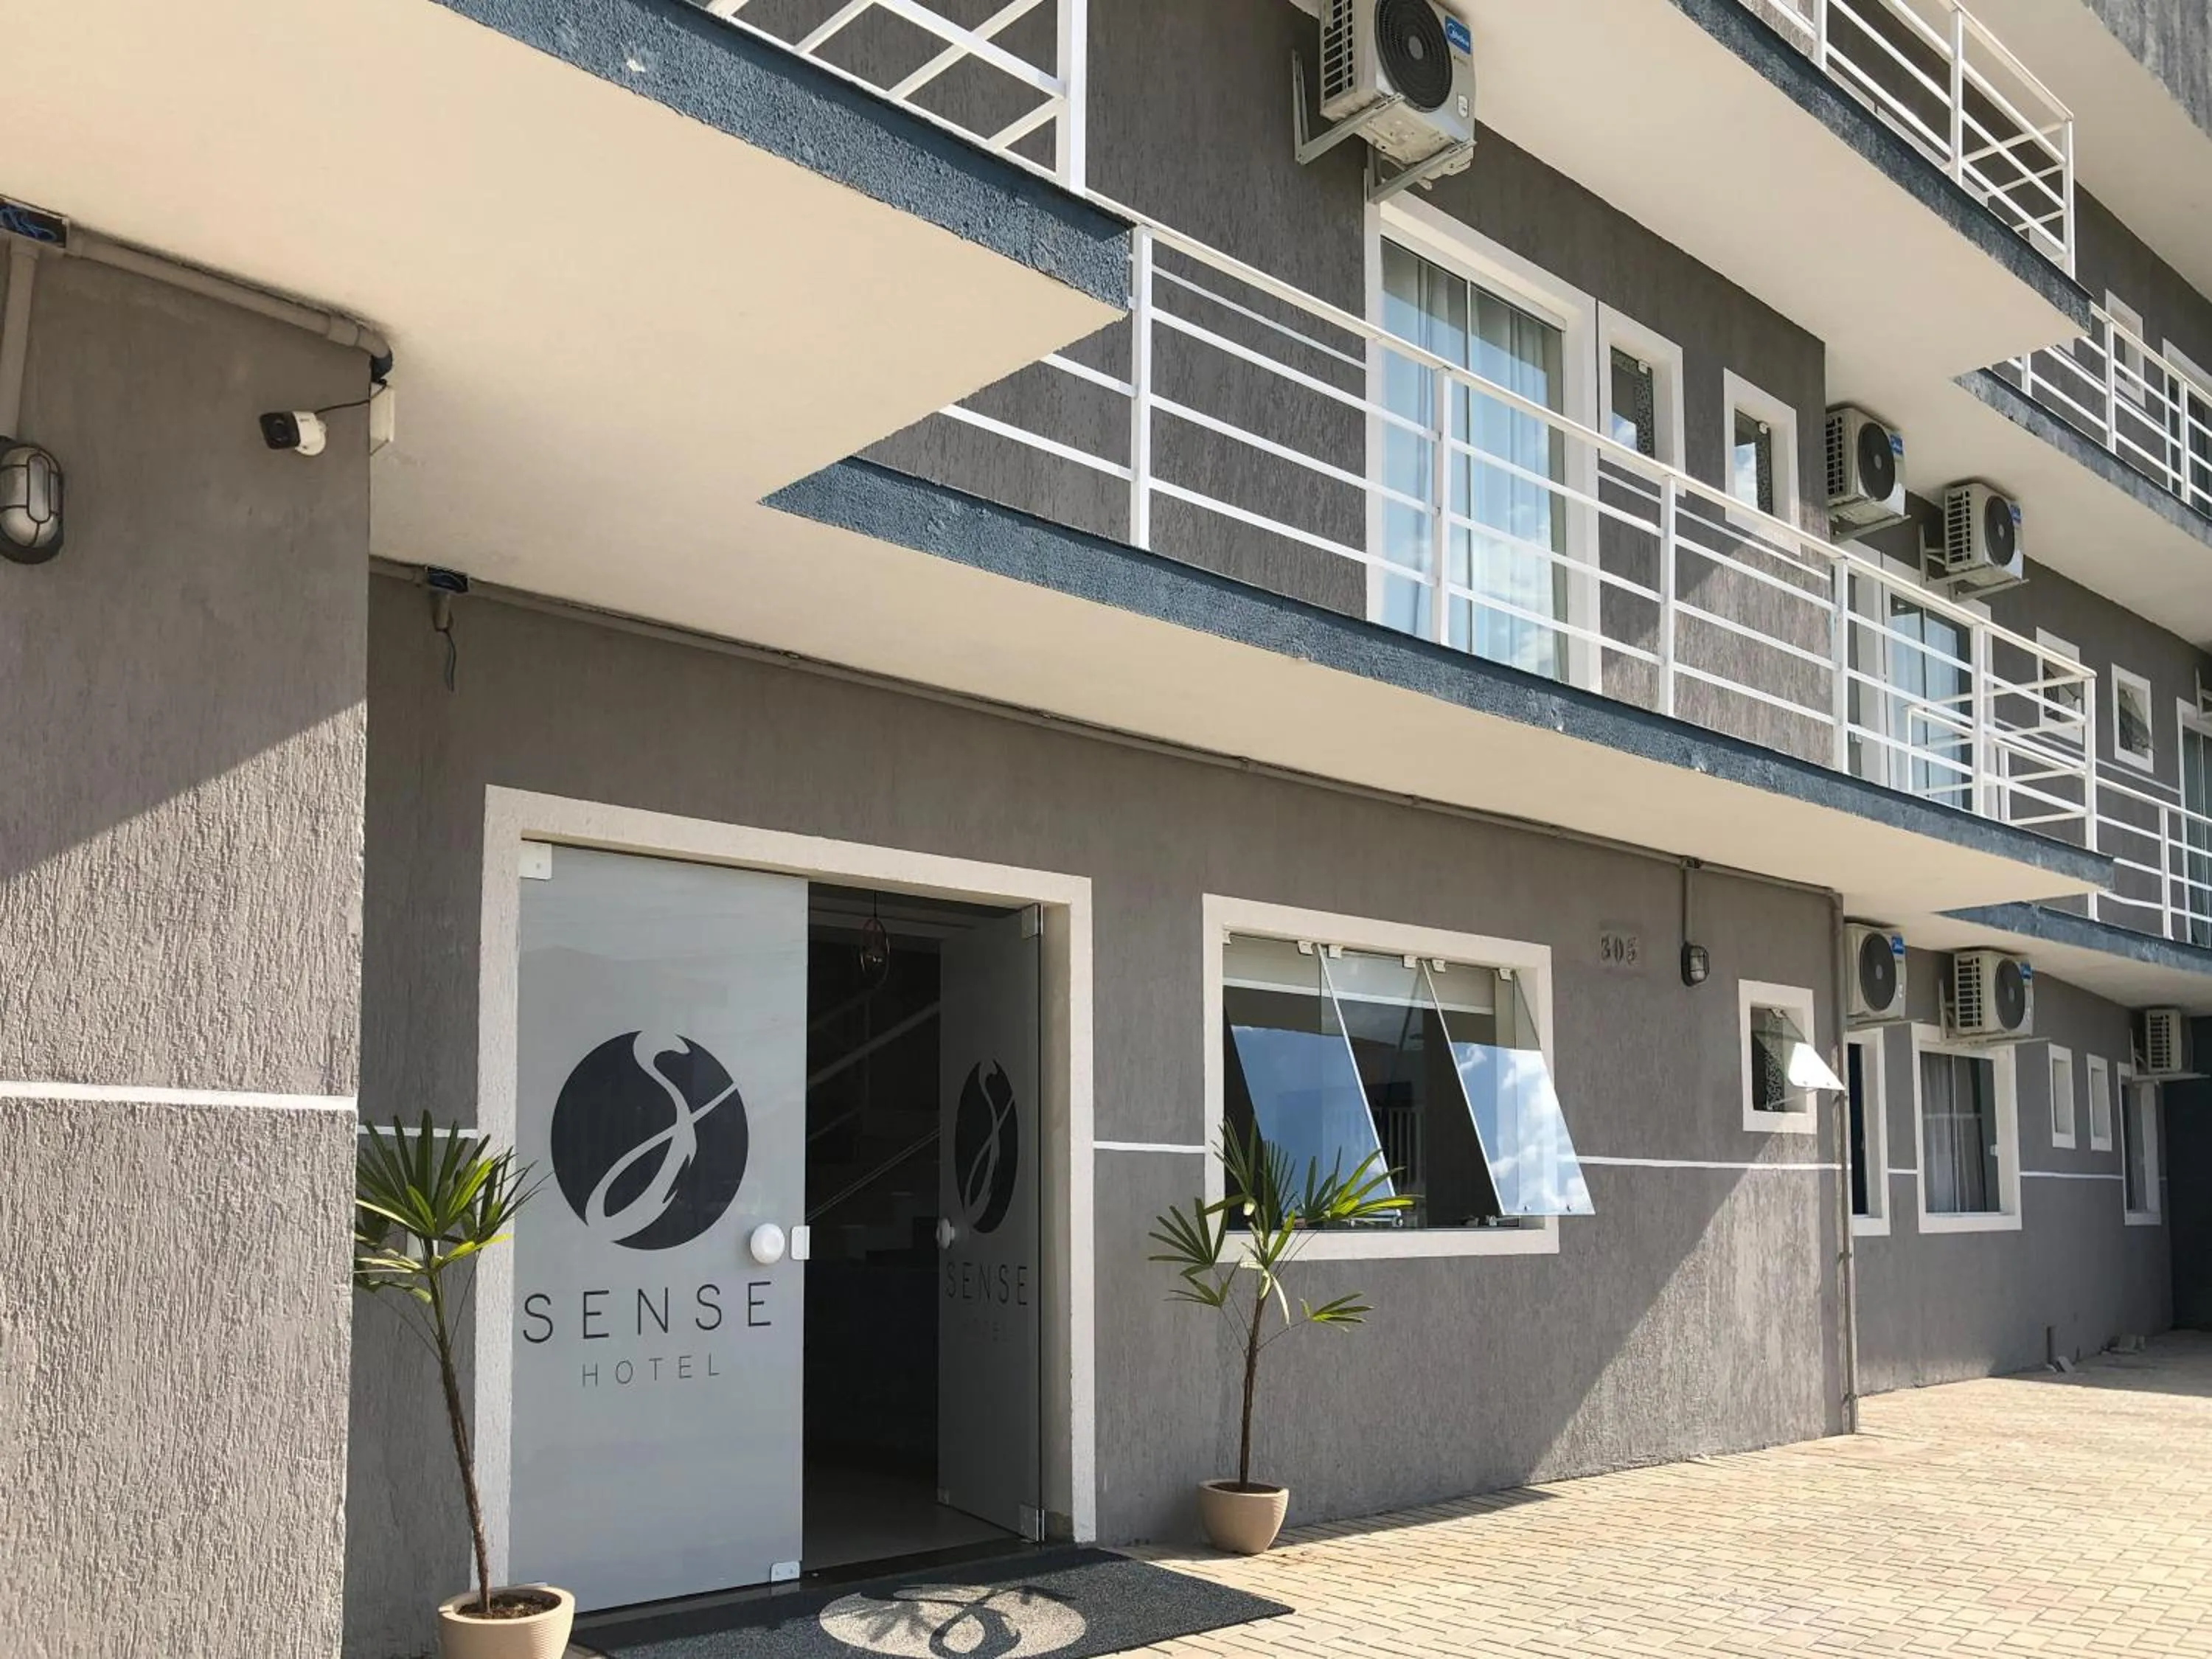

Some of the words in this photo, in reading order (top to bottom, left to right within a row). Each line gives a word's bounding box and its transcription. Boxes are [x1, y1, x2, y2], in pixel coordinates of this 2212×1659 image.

[945, 1261, 1028, 1306] SENSE
[523, 1281, 771, 1343] SENSE
[582, 1353, 720, 1386] HOTEL
